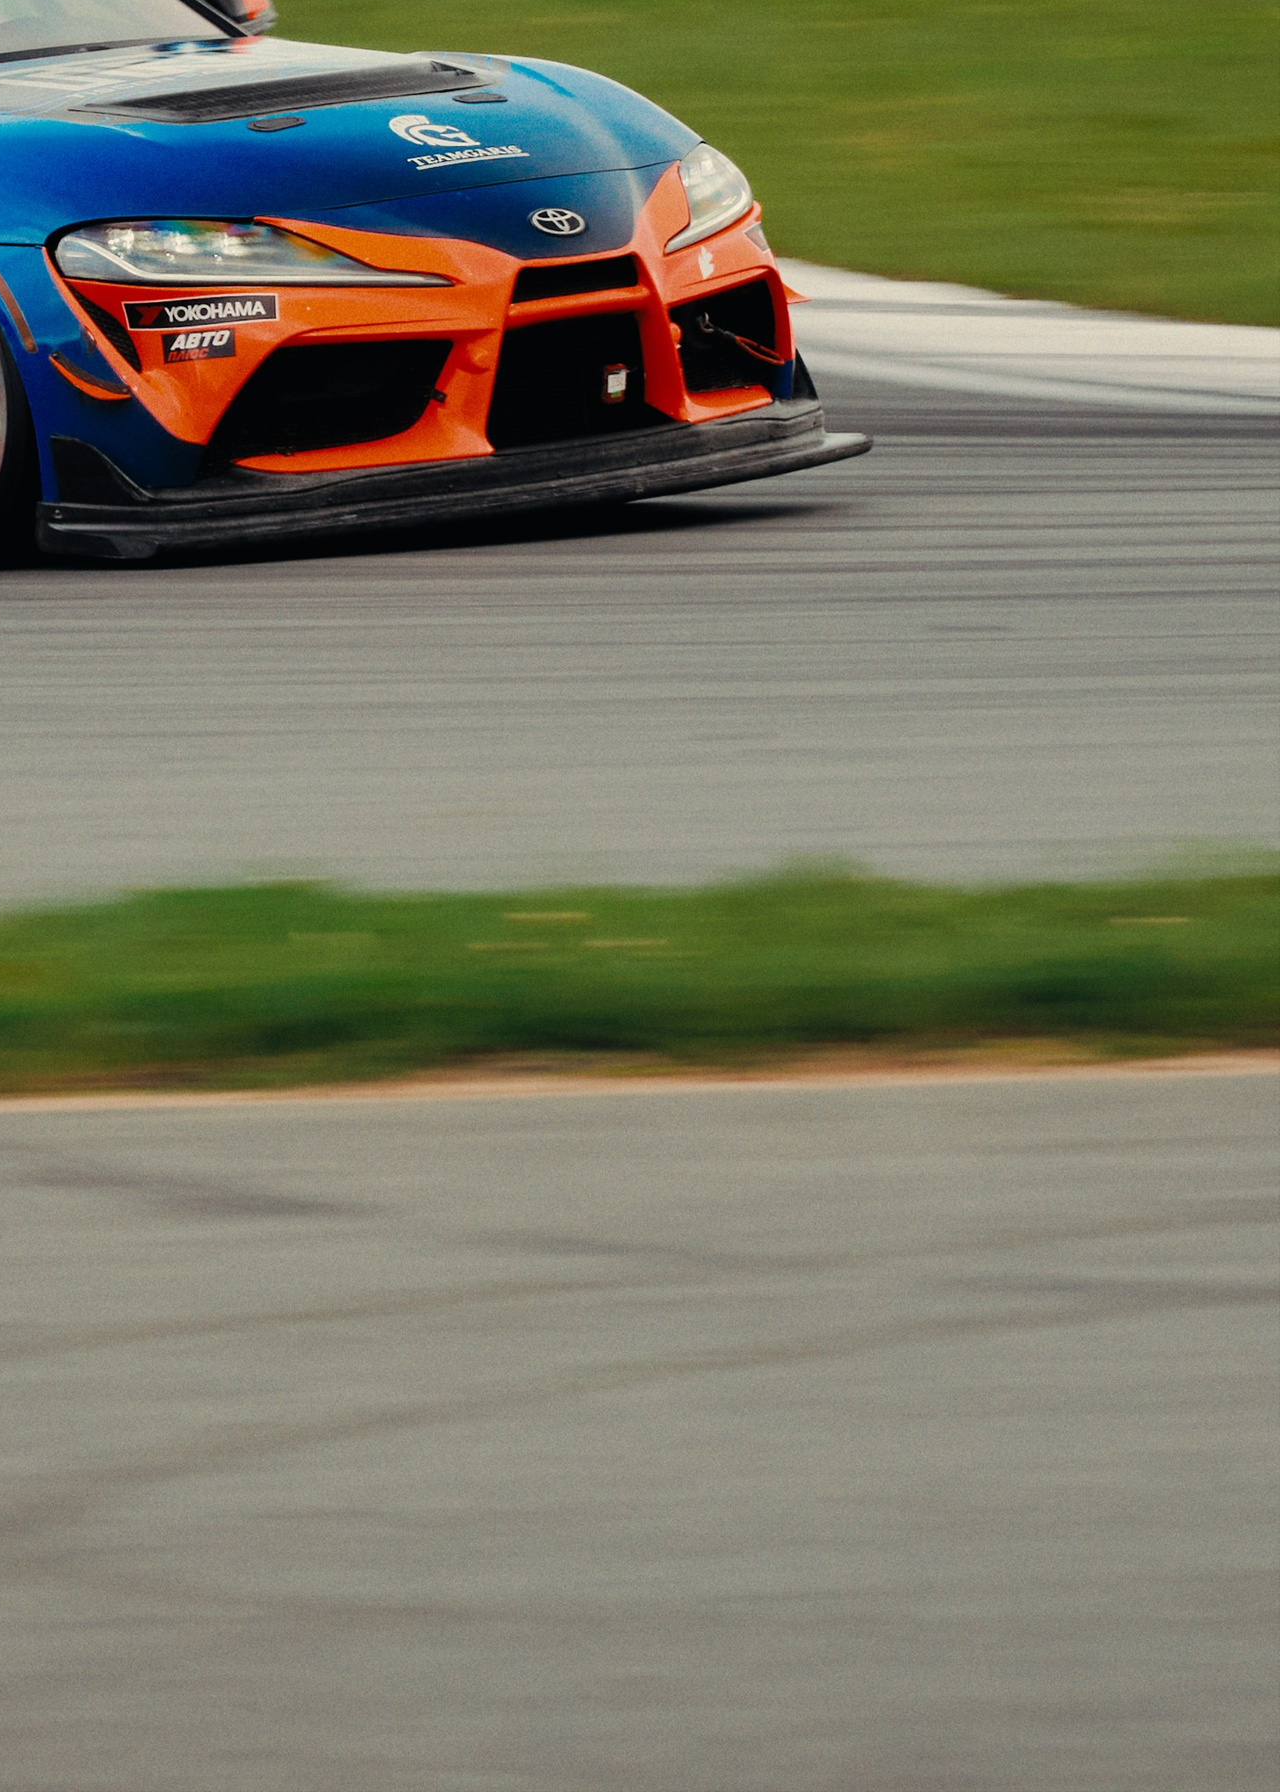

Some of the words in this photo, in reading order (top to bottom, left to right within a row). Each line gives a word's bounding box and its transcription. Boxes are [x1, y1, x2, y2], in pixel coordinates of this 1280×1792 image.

[407, 145, 523, 166] TEAMGARIS
[164, 300, 267, 323] YOKOHAMA
[170, 329, 231, 351] АВТО
